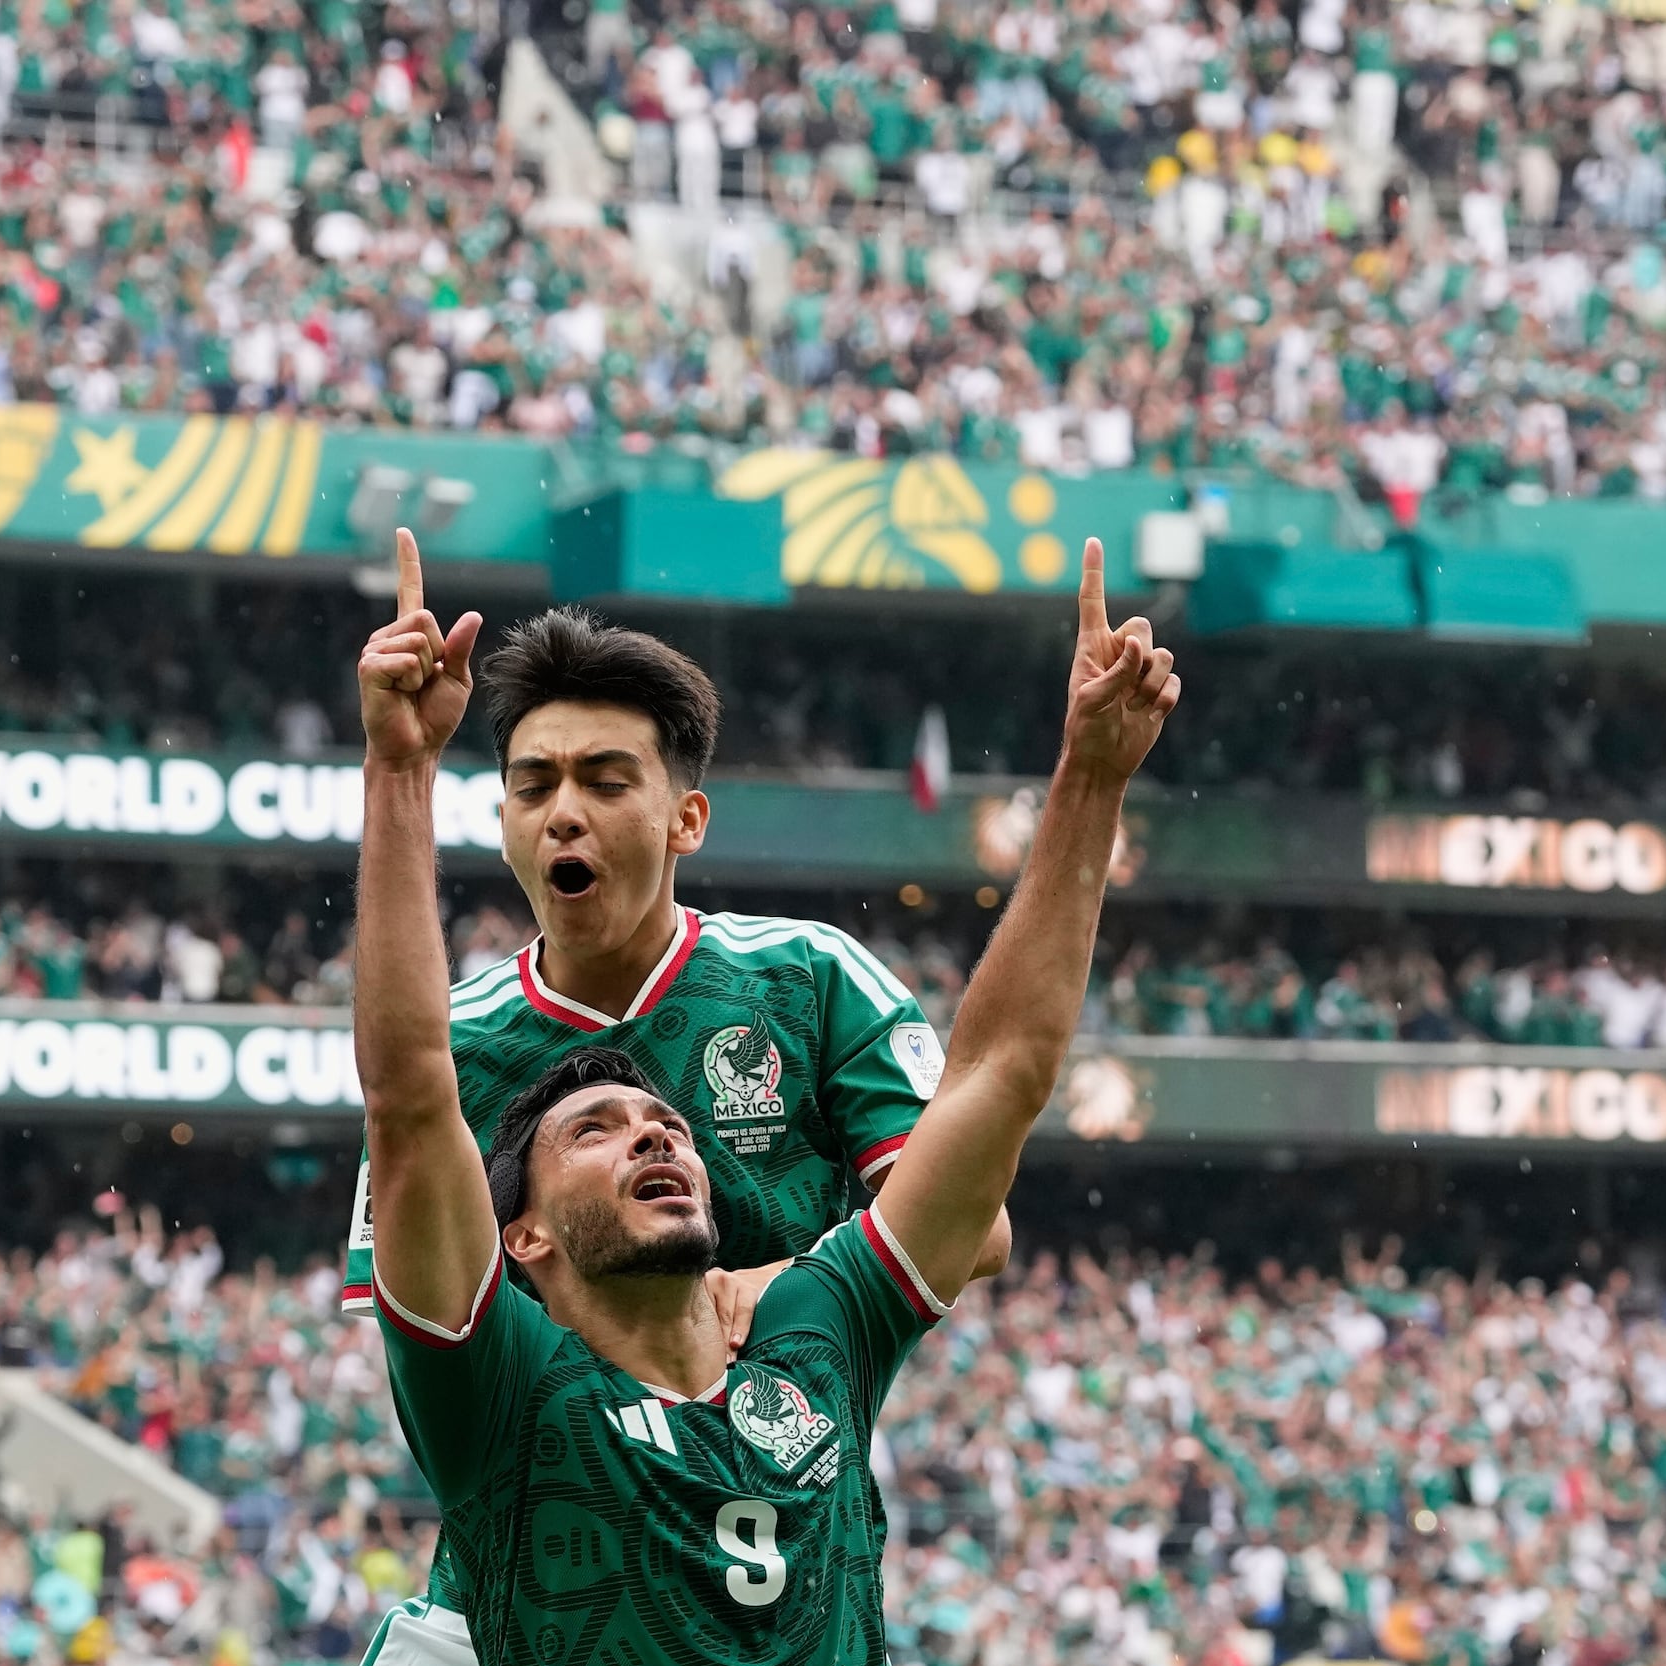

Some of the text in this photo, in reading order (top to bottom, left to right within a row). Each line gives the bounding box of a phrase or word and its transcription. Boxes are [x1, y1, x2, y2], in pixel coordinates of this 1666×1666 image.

[715, 1100, 782, 1118] MÉXICO
[748, 1126, 767, 1136] SOUTH
[740, 1136, 755, 1145] JUNE
[755, 1135, 771, 1143] 2026
[735, 1143, 771, 1155] MEXICO CITY
[778, 1418, 830, 1468] MÉXICO
[715, 1499, 787, 1607] 9
